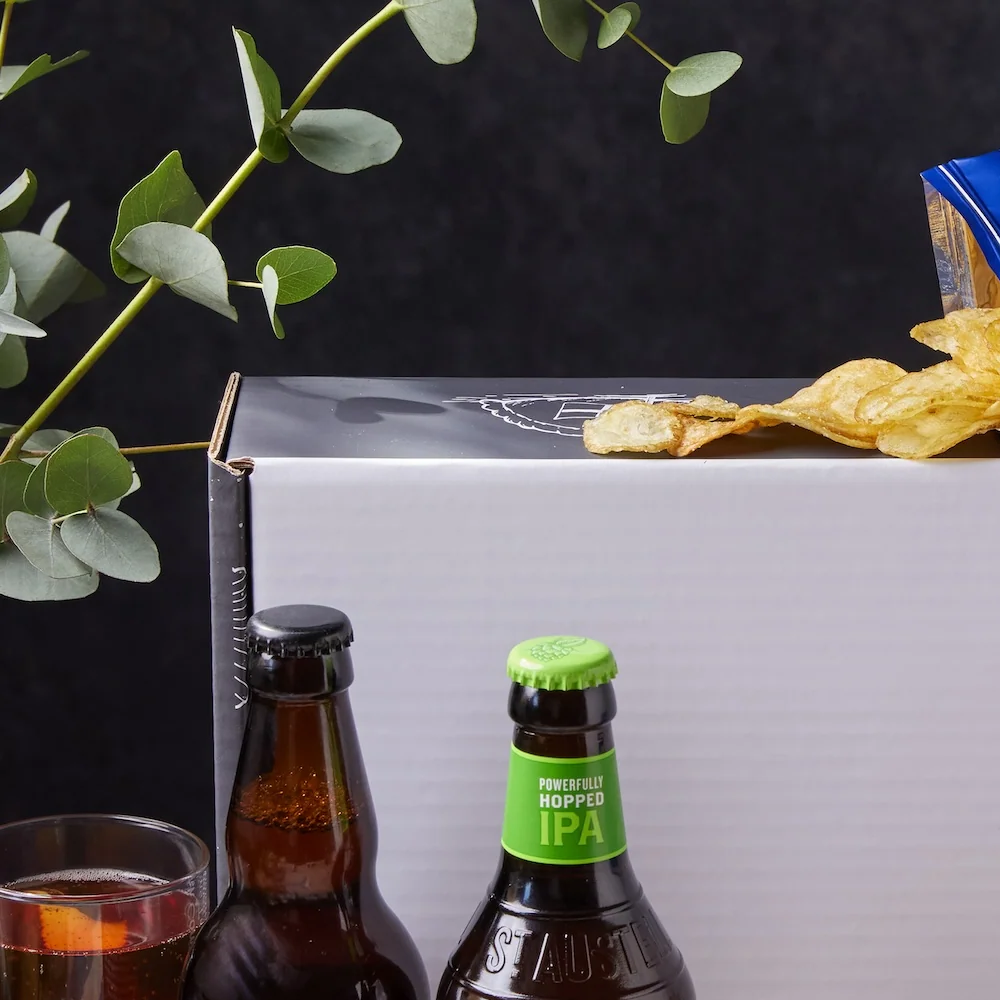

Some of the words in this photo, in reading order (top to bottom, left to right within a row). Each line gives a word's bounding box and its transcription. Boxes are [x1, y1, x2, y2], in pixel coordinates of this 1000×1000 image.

[539, 775, 604, 792] POWERFULLY
[540, 792, 604, 809] HOPPED
[539, 809, 604, 846] IPA
